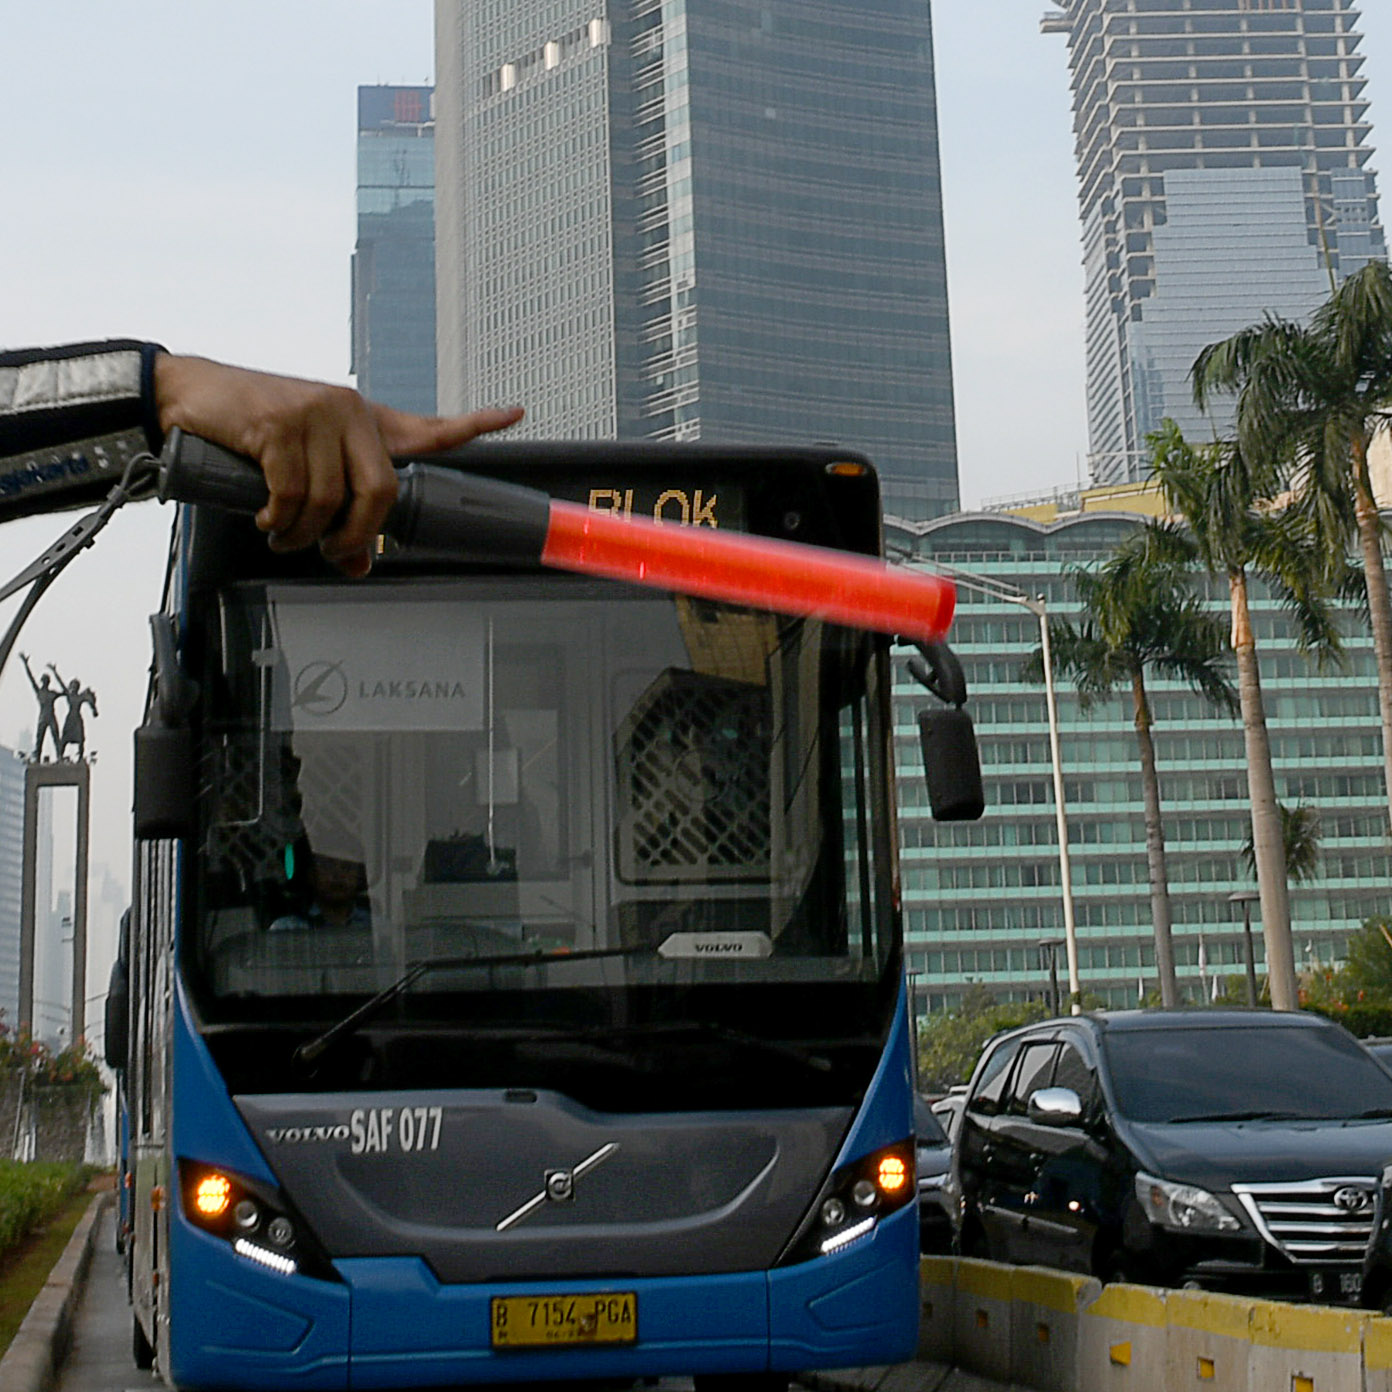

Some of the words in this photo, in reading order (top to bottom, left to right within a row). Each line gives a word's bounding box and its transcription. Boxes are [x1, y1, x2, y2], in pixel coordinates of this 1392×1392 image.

[358, 679, 467, 699] LAKSANA
[695, 943, 743, 952] VOLVO
[266, 1124, 350, 1142] VOLVO
[350, 1109, 394, 1155] SAF
[399, 1107, 443, 1152] 077
[496, 1303, 508, 1329] B
[528, 1300, 577, 1327] 7154
